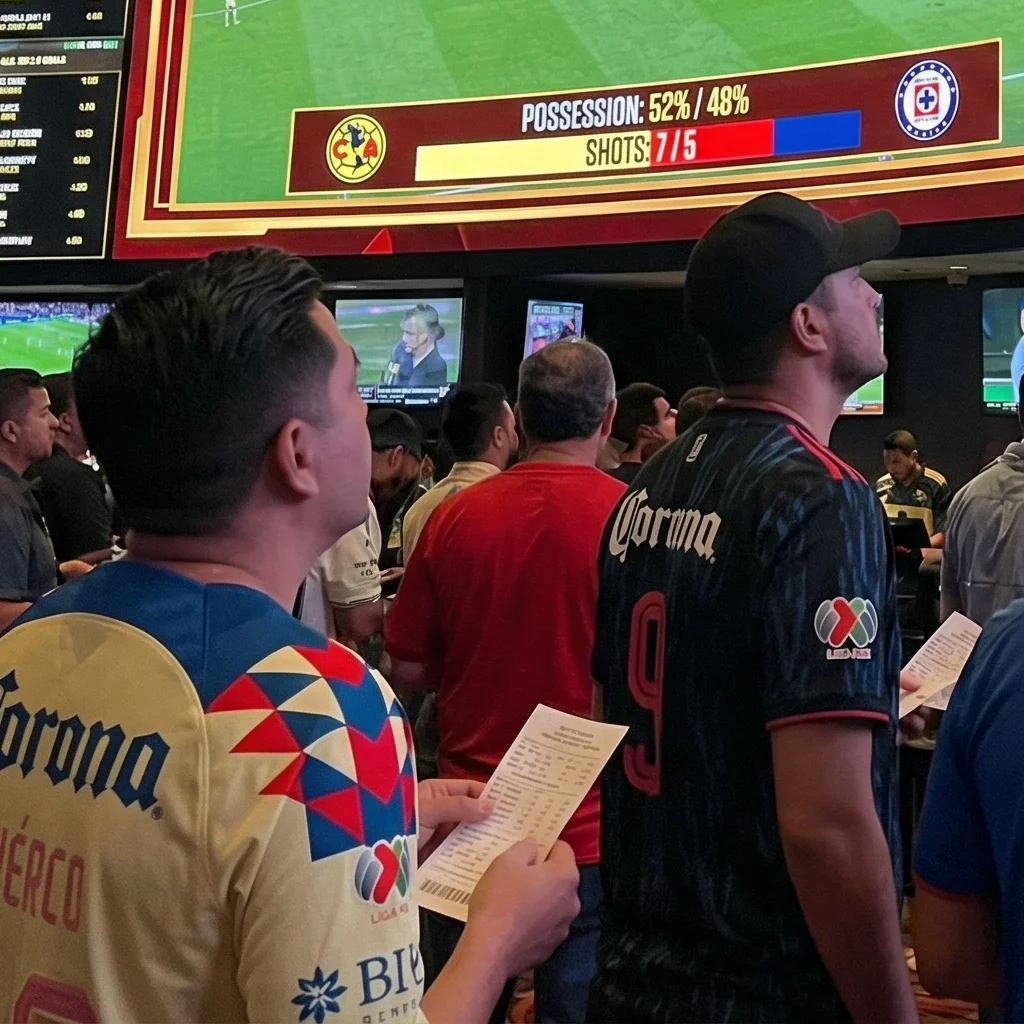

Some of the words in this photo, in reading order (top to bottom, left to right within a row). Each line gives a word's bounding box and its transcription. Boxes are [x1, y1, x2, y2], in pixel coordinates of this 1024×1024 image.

[521, 94, 645, 133] POSSESSION:
[649, 89, 690, 123] 52%
[706, 84, 750, 117] 48%
[586, 135, 650, 166] SHOTS:
[623, 590, 666, 797] 9
